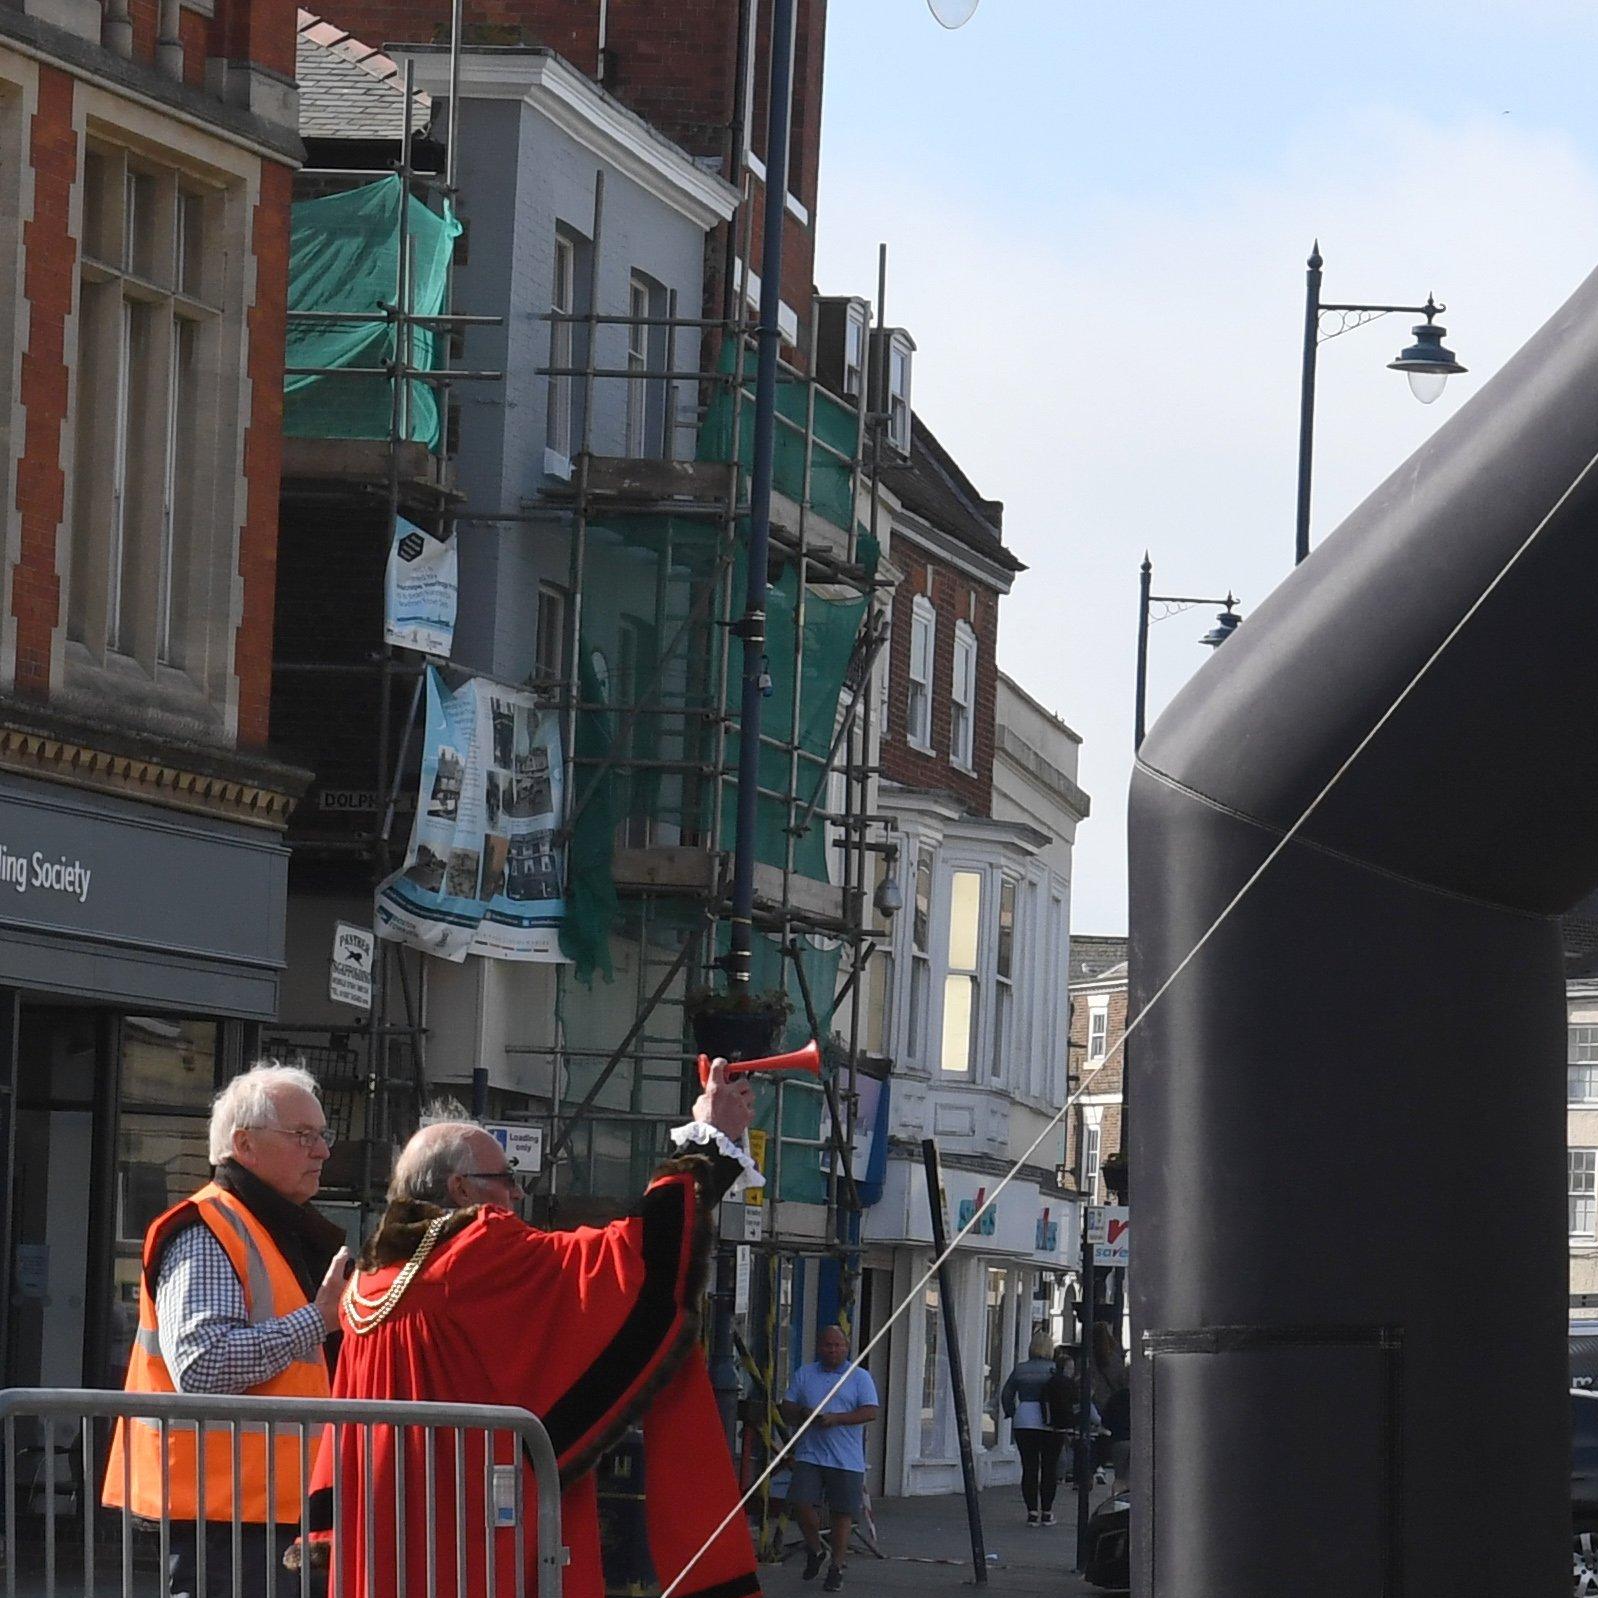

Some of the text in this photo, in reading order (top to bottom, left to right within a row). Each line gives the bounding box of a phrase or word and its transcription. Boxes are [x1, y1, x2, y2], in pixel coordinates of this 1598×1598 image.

[325, 792, 377, 808] DOLPH
[0, 844, 91, 903] ing Society
[509, 1133, 539, 1144] Loading
[515, 1143, 531, 1153] only
